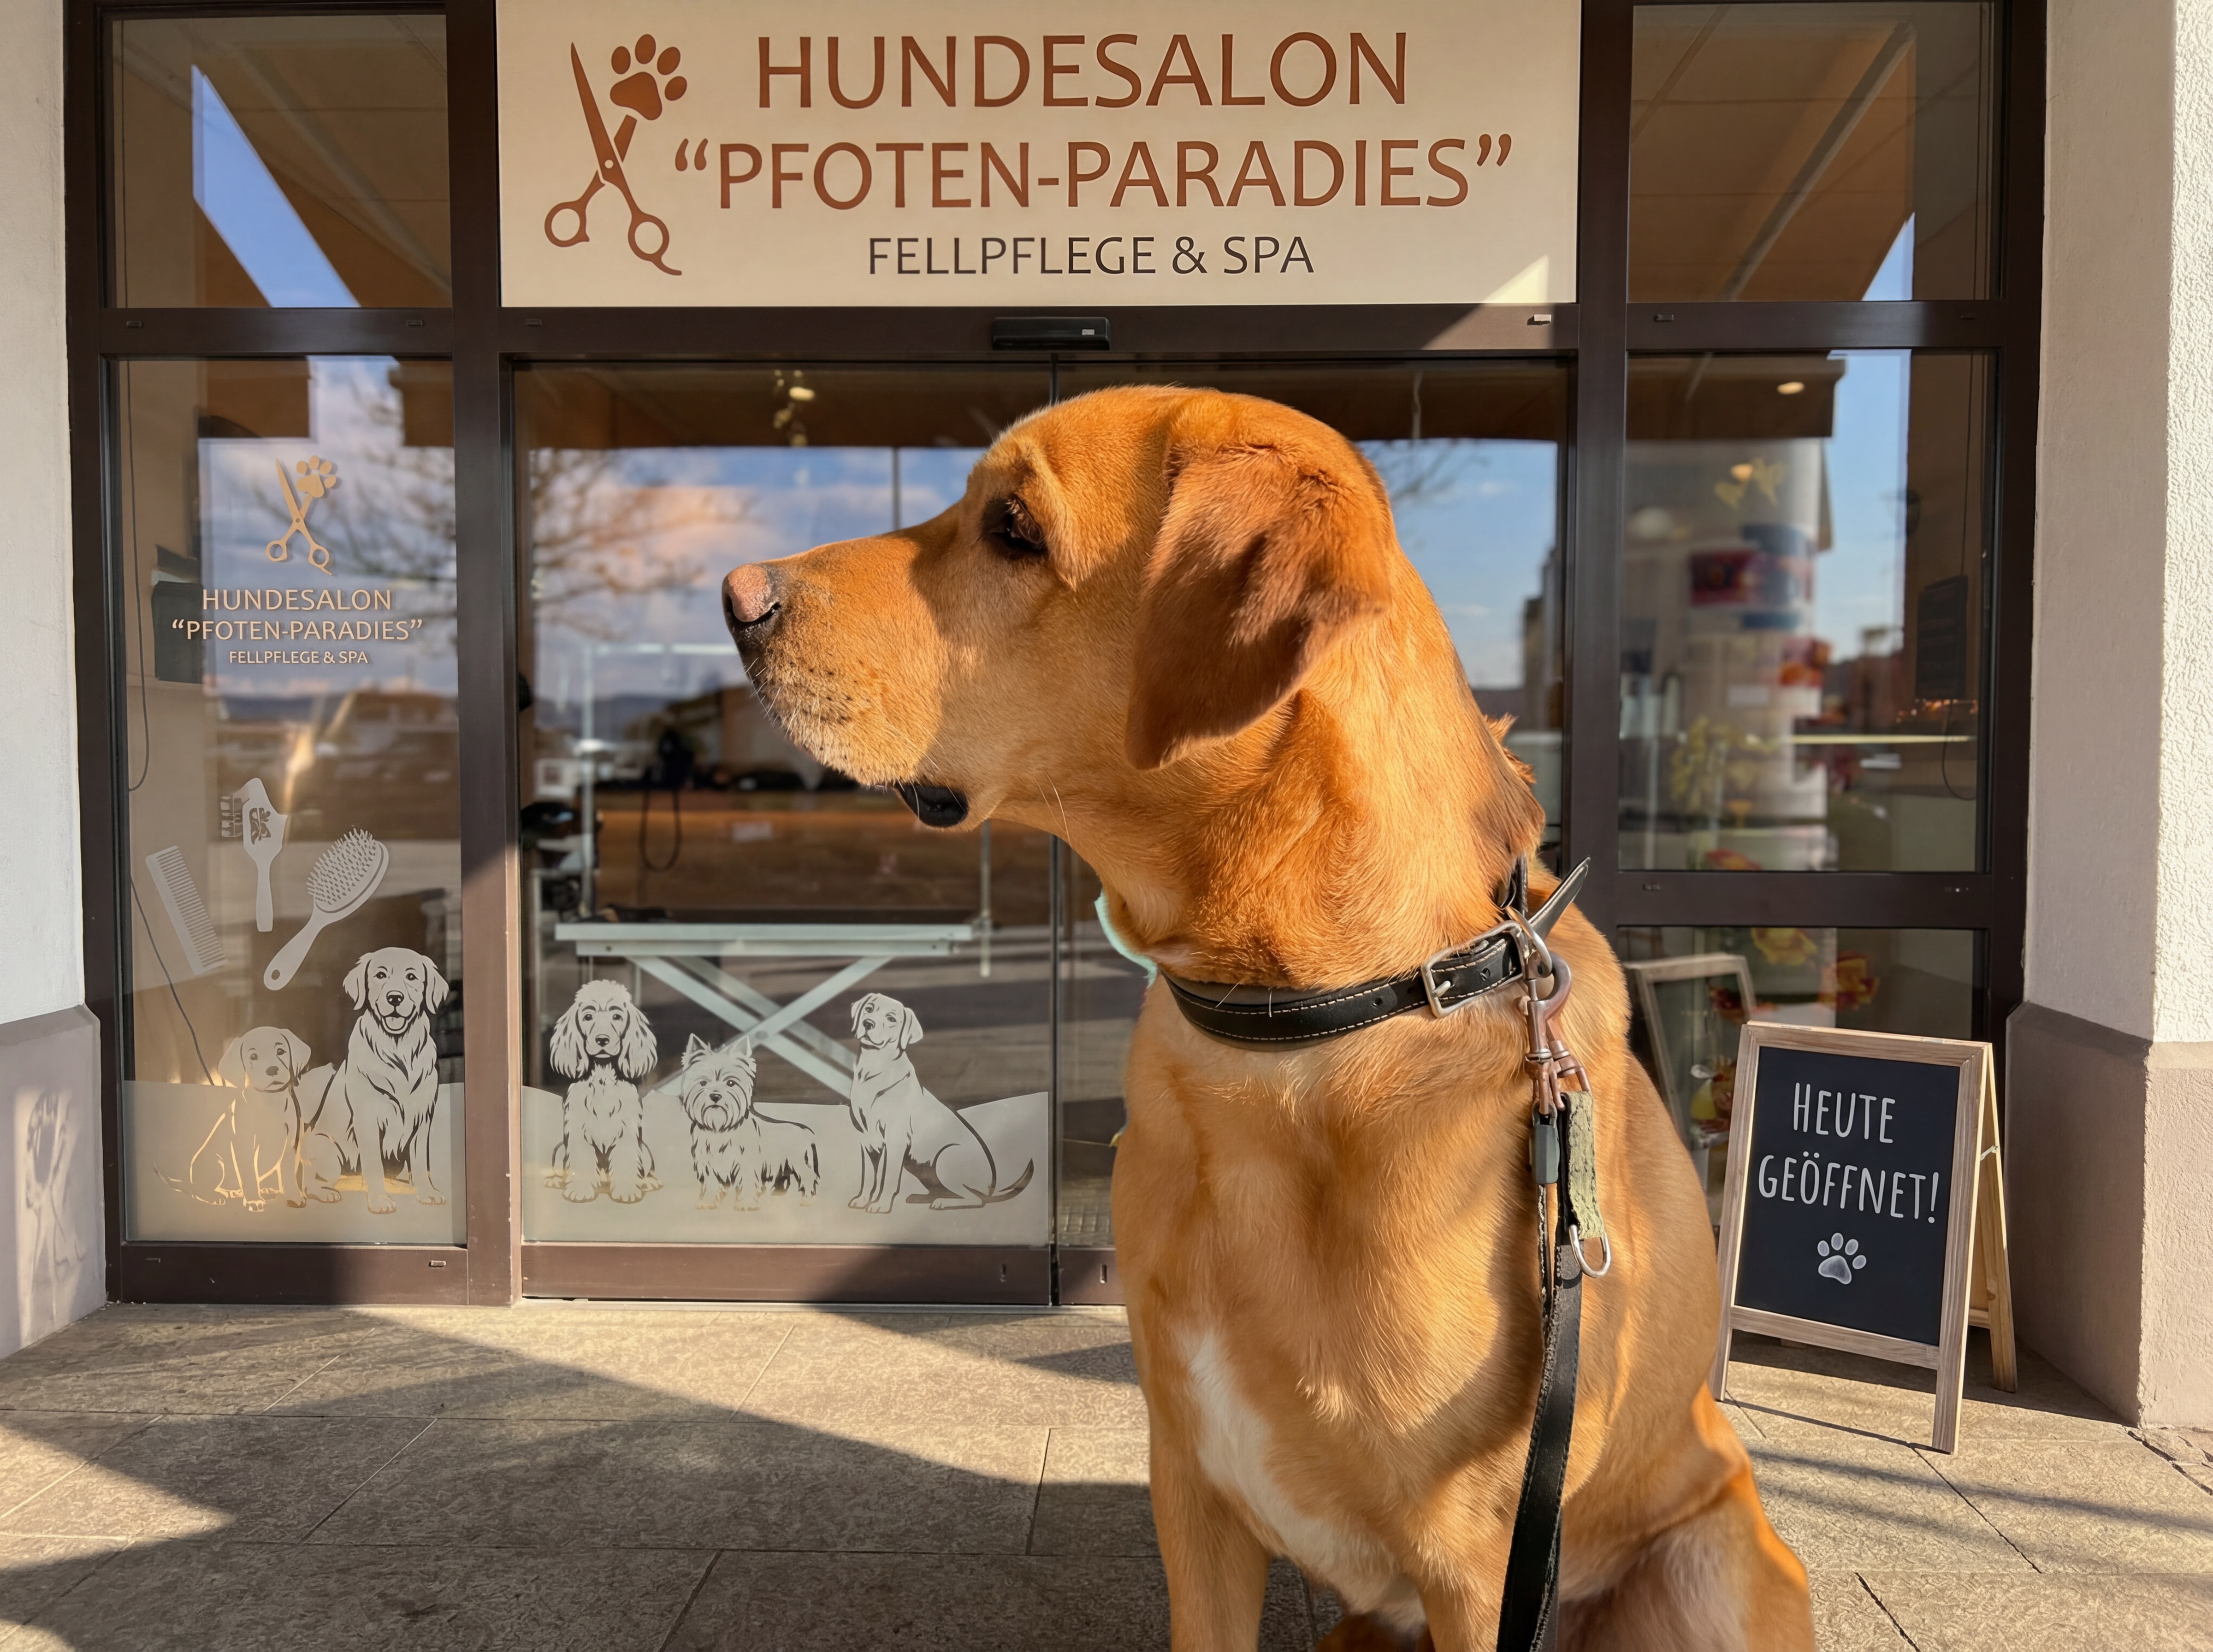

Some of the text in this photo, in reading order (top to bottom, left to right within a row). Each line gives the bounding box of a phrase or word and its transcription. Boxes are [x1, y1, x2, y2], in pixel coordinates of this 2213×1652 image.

[757, 31, 1407, 110] HUNDESALON
[674, 133, 1512, 211] “PFOTEN-PARADIES”
[869, 236, 1314, 275] FELLPFLEGE & SPA
[202, 589, 391, 611] HUNDESALON
[172, 619, 423, 641] “PFOTEN-PARADIES”
[229, 650, 368, 664] FELLPFLEGE & SPA
[1793, 1082, 1896, 1144] HEUTE
[1758, 1150, 1940, 1224] GEÖFFNET!
